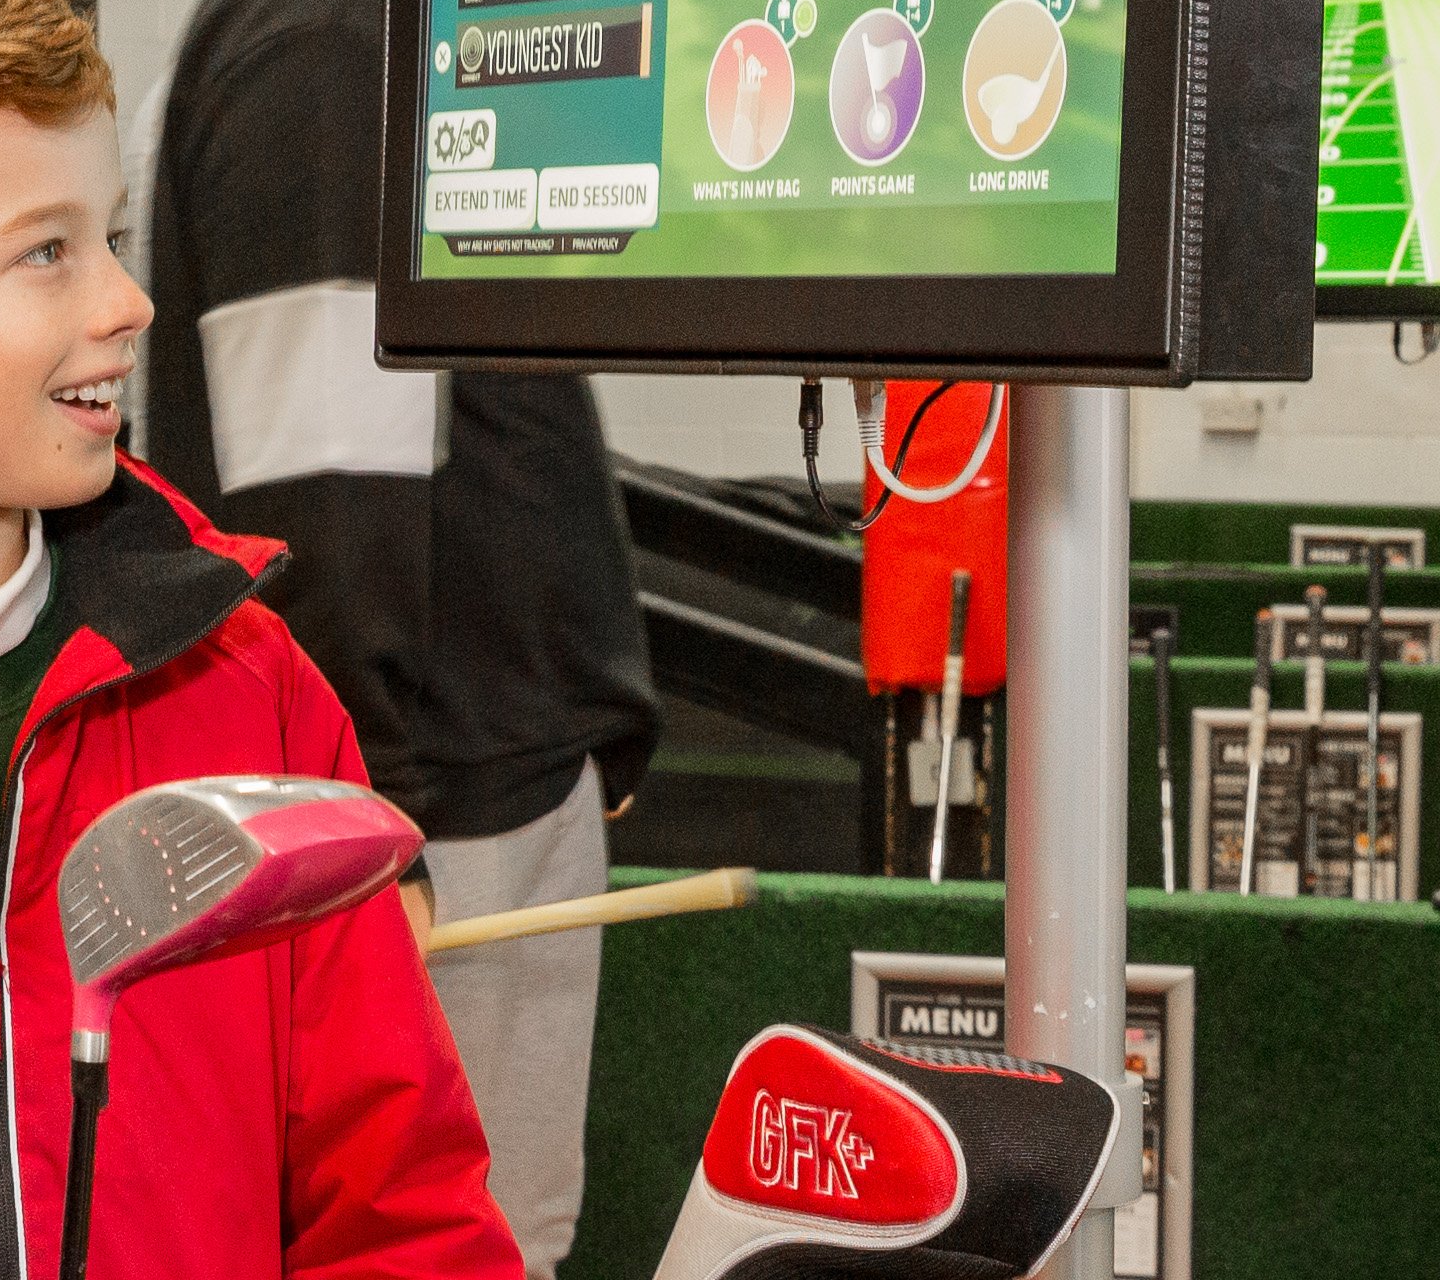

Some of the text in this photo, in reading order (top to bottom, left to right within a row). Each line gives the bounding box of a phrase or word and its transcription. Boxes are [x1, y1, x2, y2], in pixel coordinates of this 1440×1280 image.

[487, 21, 604, 76] YOUNGEST KID
[693, 178, 801, 201] WHAT'S IN MY BAG
[830, 174, 916, 195] POINTS GAME
[969, 169, 1050, 192] LONG DRIVE
[434, 188, 528, 212] EXTEND TIME
[549, 184, 648, 208] END SESSION
[901, 1006, 998, 1038] MENU
[750, 1088, 875, 1200] GFK+
